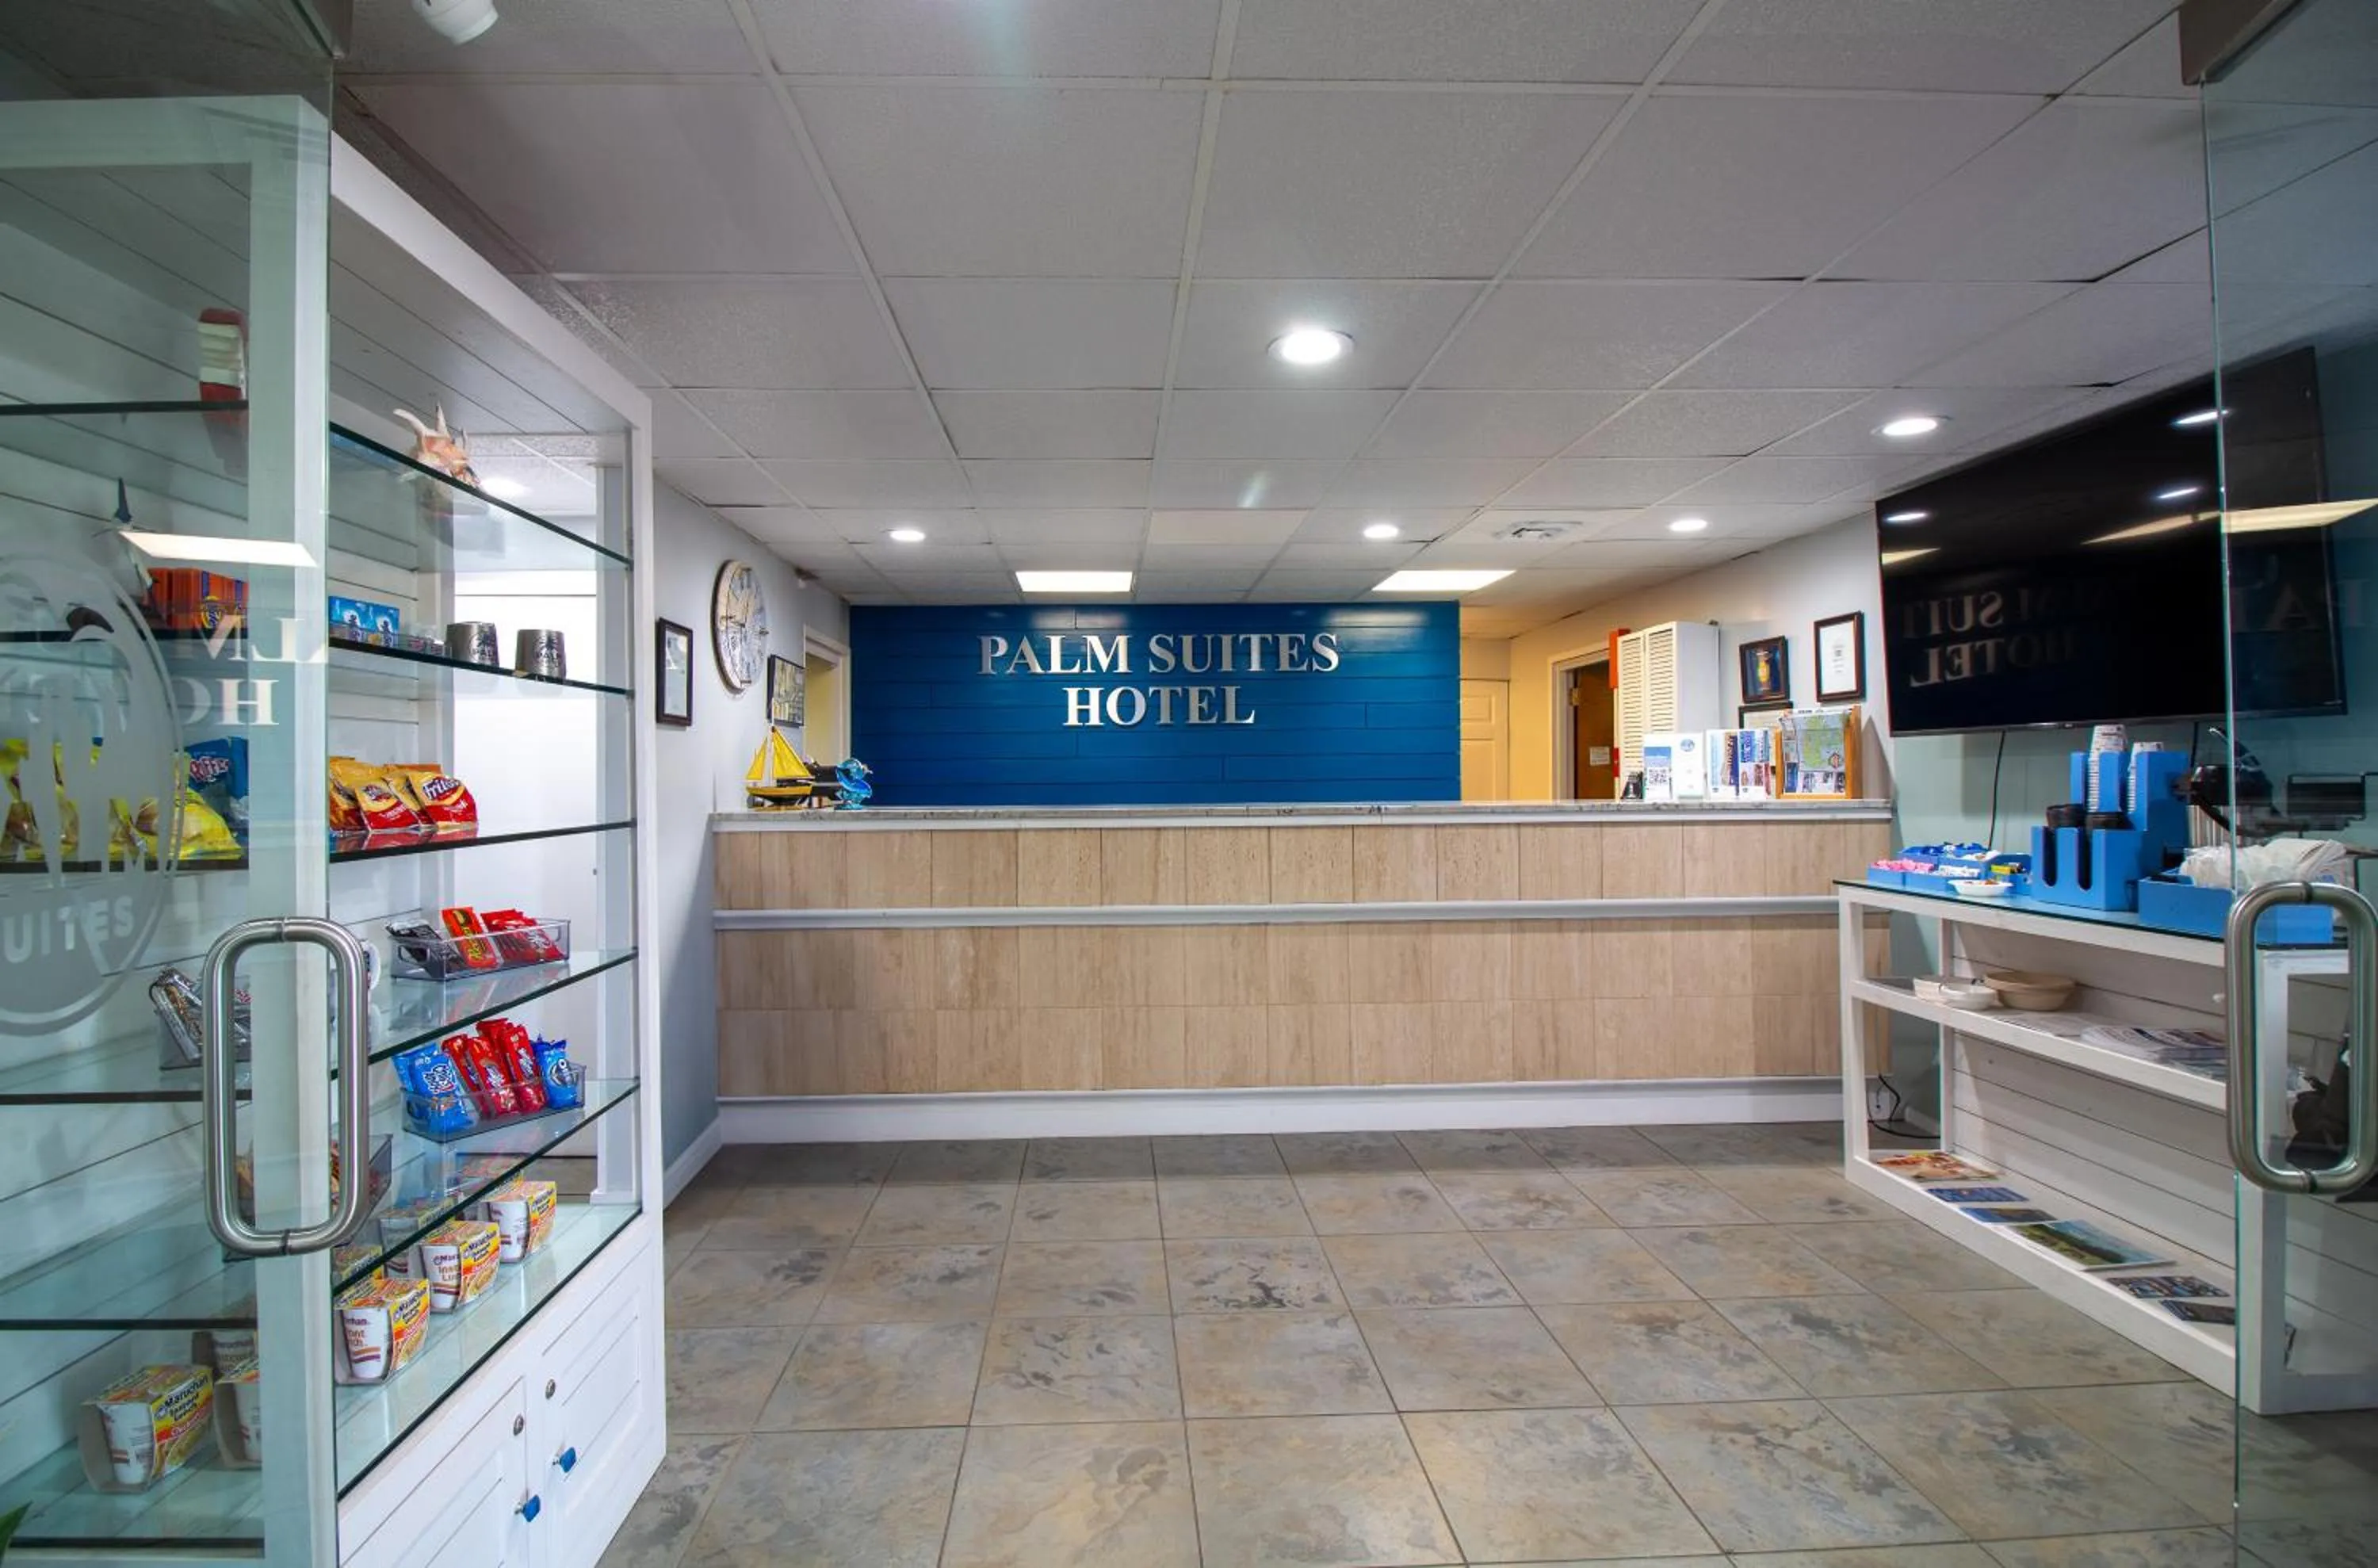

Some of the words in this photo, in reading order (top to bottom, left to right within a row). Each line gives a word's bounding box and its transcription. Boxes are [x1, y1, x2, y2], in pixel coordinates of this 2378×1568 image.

[976, 633, 1134, 675] PALM
[1149, 633, 1341, 672] SUITES
[1062, 686, 1256, 726] HOTEL
[3, 895, 135, 964] UITES
